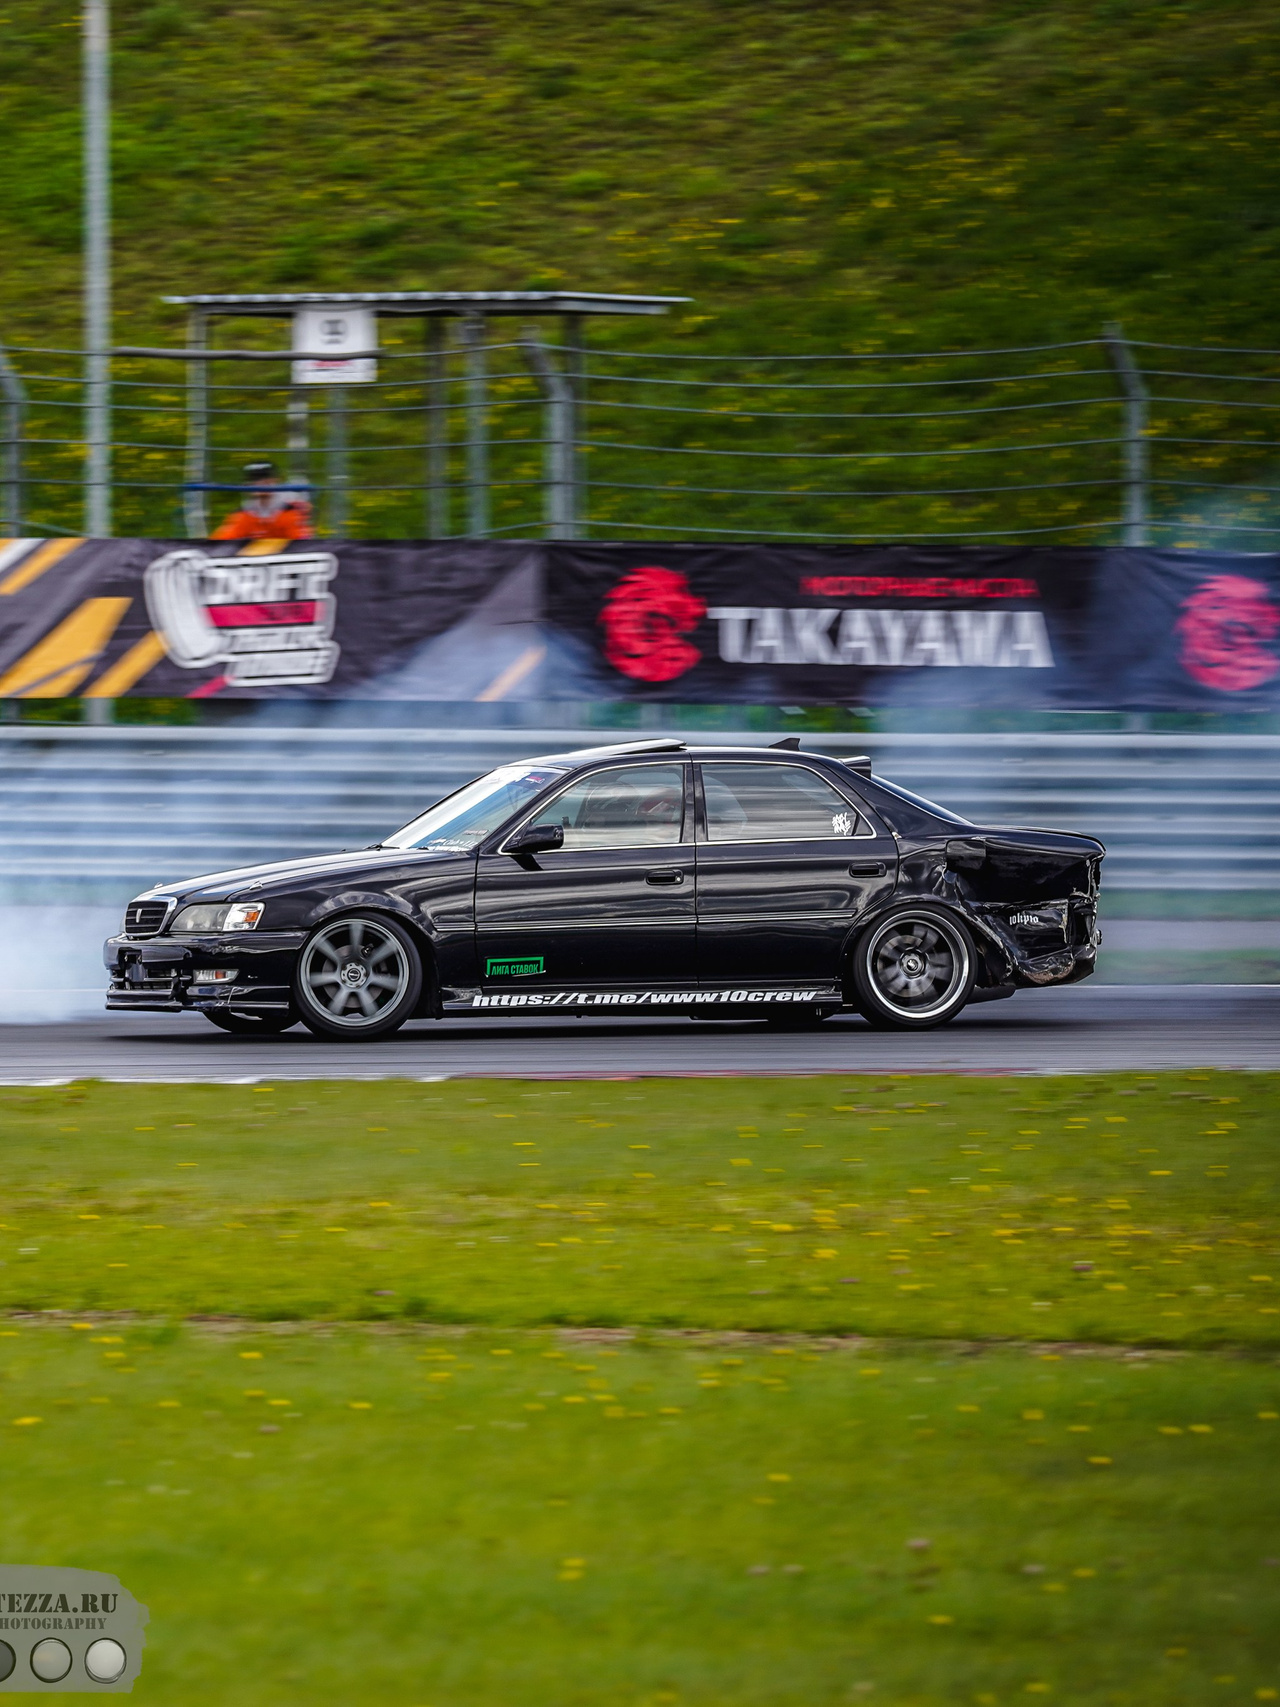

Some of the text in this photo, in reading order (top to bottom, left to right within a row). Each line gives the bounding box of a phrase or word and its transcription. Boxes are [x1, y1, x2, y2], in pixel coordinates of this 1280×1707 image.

[491, 964, 539, 976] ЛИГА СТАВОК
[472, 990, 818, 1008] https://t.me/www10crew
